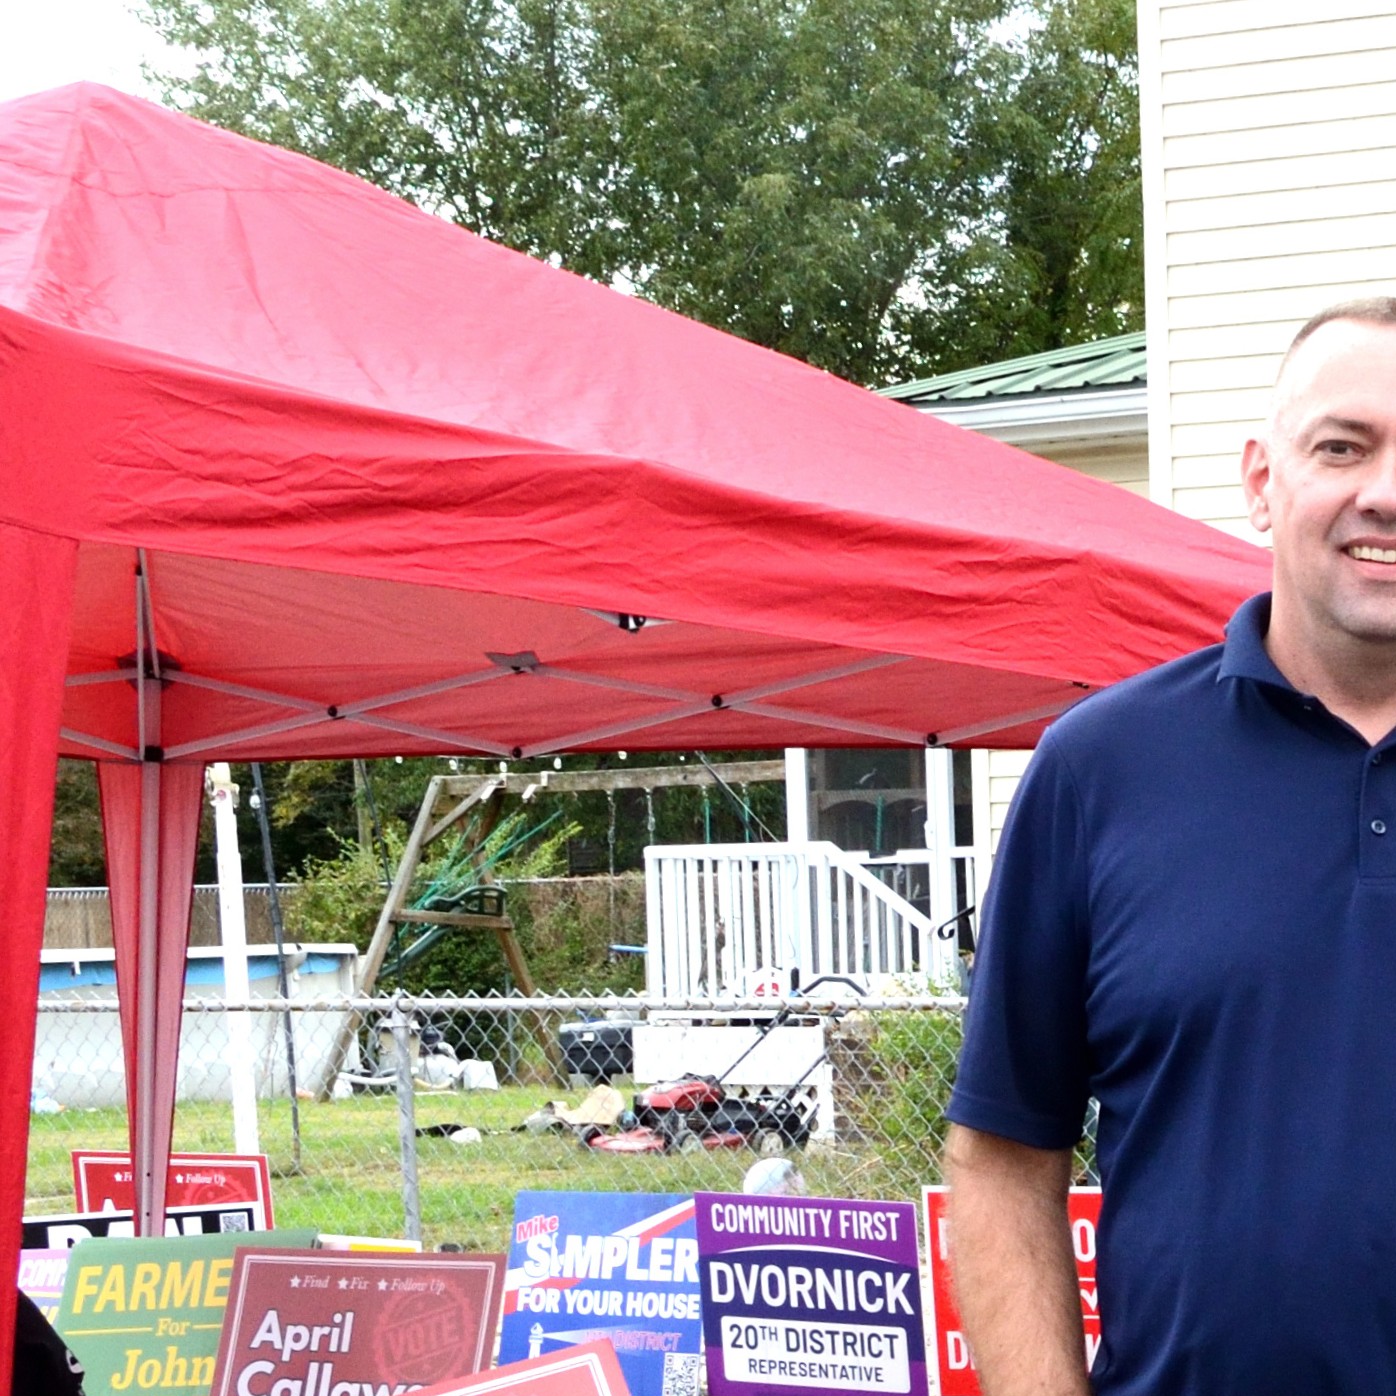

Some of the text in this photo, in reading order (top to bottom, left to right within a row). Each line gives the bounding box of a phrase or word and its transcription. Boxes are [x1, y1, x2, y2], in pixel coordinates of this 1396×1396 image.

[186, 1173, 226, 1186] Follow Up
[516, 1214, 559, 1244] Mike
[710, 1203, 832, 1238] COMMUNITY
[839, 1209, 900, 1241] FIRST
[303, 1275, 329, 1288] Find
[350, 1277, 369, 1289] Fix
[391, 1278, 446, 1295] Follow Up
[709, 1261, 915, 1315] DVORNICK
[516, 1286, 700, 1320] FOR YOUR HOUSE
[156, 1318, 190, 1336] For
[250, 1310, 355, 1362] April
[616, 1329, 682, 1351] DISTRICT
[729, 1324, 899, 1359] 20TH DISTRICT
[748, 1358, 884, 1382] REPRESENTATIVE
